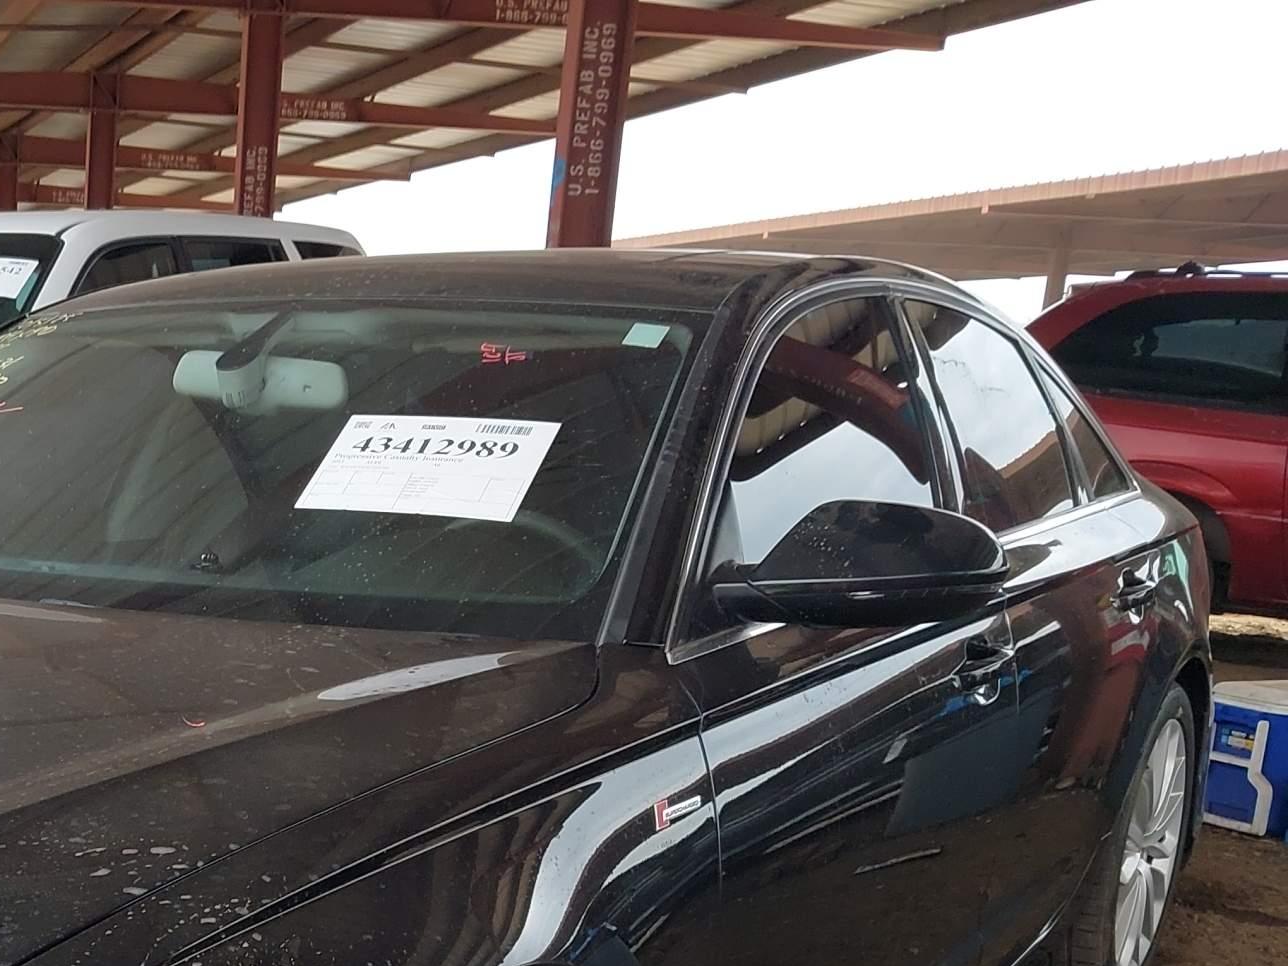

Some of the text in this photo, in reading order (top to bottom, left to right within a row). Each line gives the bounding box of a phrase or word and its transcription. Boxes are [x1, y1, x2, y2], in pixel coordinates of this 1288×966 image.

[582, 21, 601, 60] INC.
[572, 70, 595, 148] PREFAB
[584, 23, 618, 195] 1-866-799-0969
[352, 436, 519, 460] 43412989
